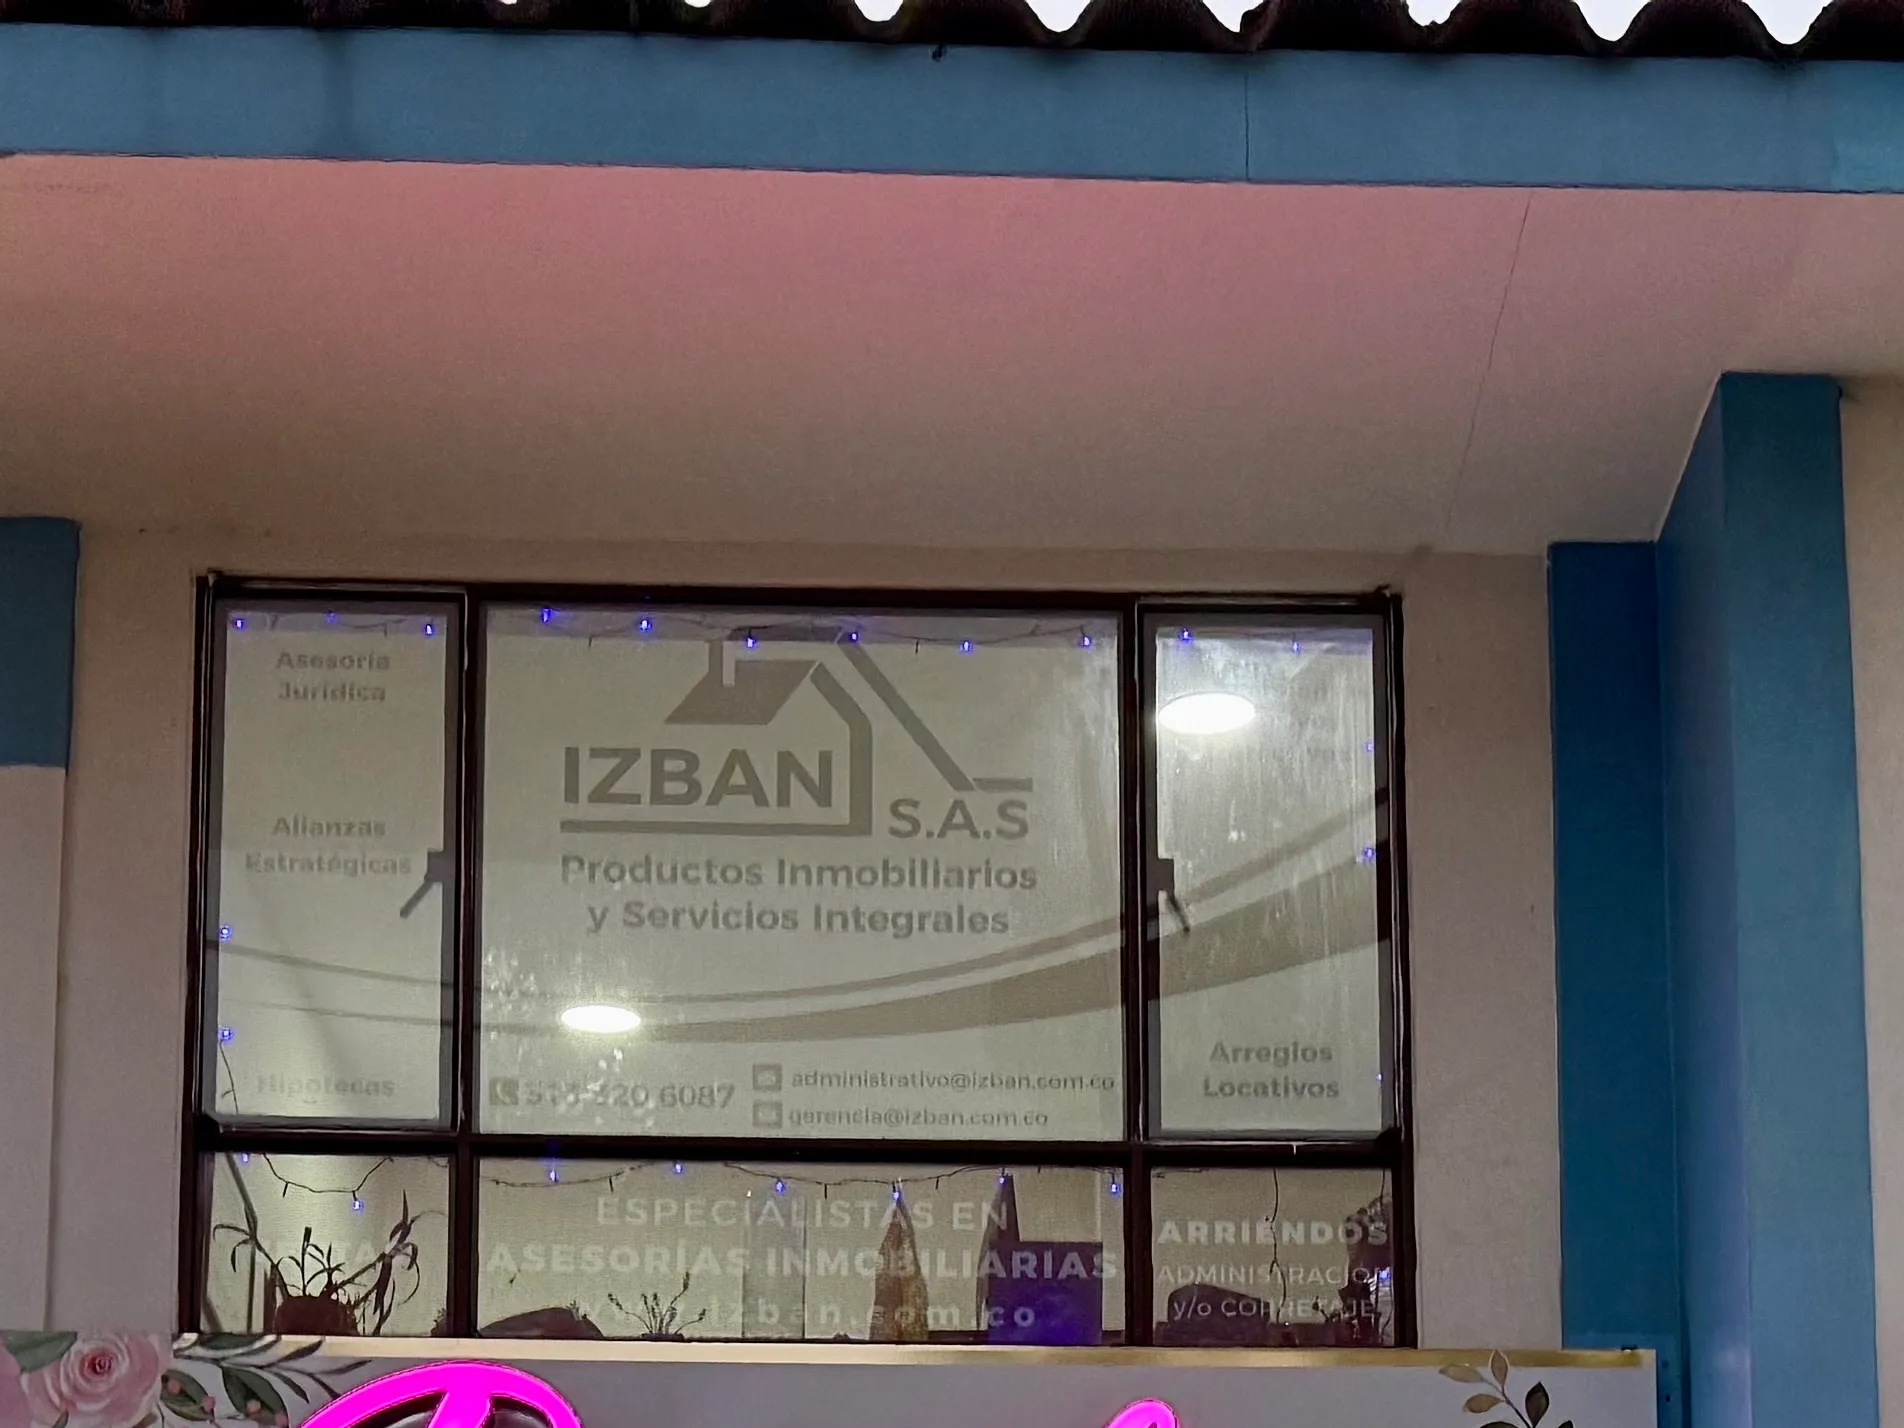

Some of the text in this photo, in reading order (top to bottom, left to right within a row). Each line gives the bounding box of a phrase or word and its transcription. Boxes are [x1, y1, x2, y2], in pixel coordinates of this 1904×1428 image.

[562, 747, 834, 808] IZBAN
[886, 797, 1032, 841] S.A.S
[560, 854, 1038, 890] Productos Inmobiliarios
[586, 901, 1010, 939] y Servicios Integrales
[1208, 1041, 1333, 1070] Arreglos
[1202, 1075, 1340, 1101] Locativos
[595, 1198, 1008, 1231] ESPECIALISTAS EN
[1156, 1219, 1389, 1247] ARRIENDOS
[486, 1238, 1119, 1281] ASESORÍAS INMOBILIARIAS
[1173, 1296, 1212, 1321] y/o
